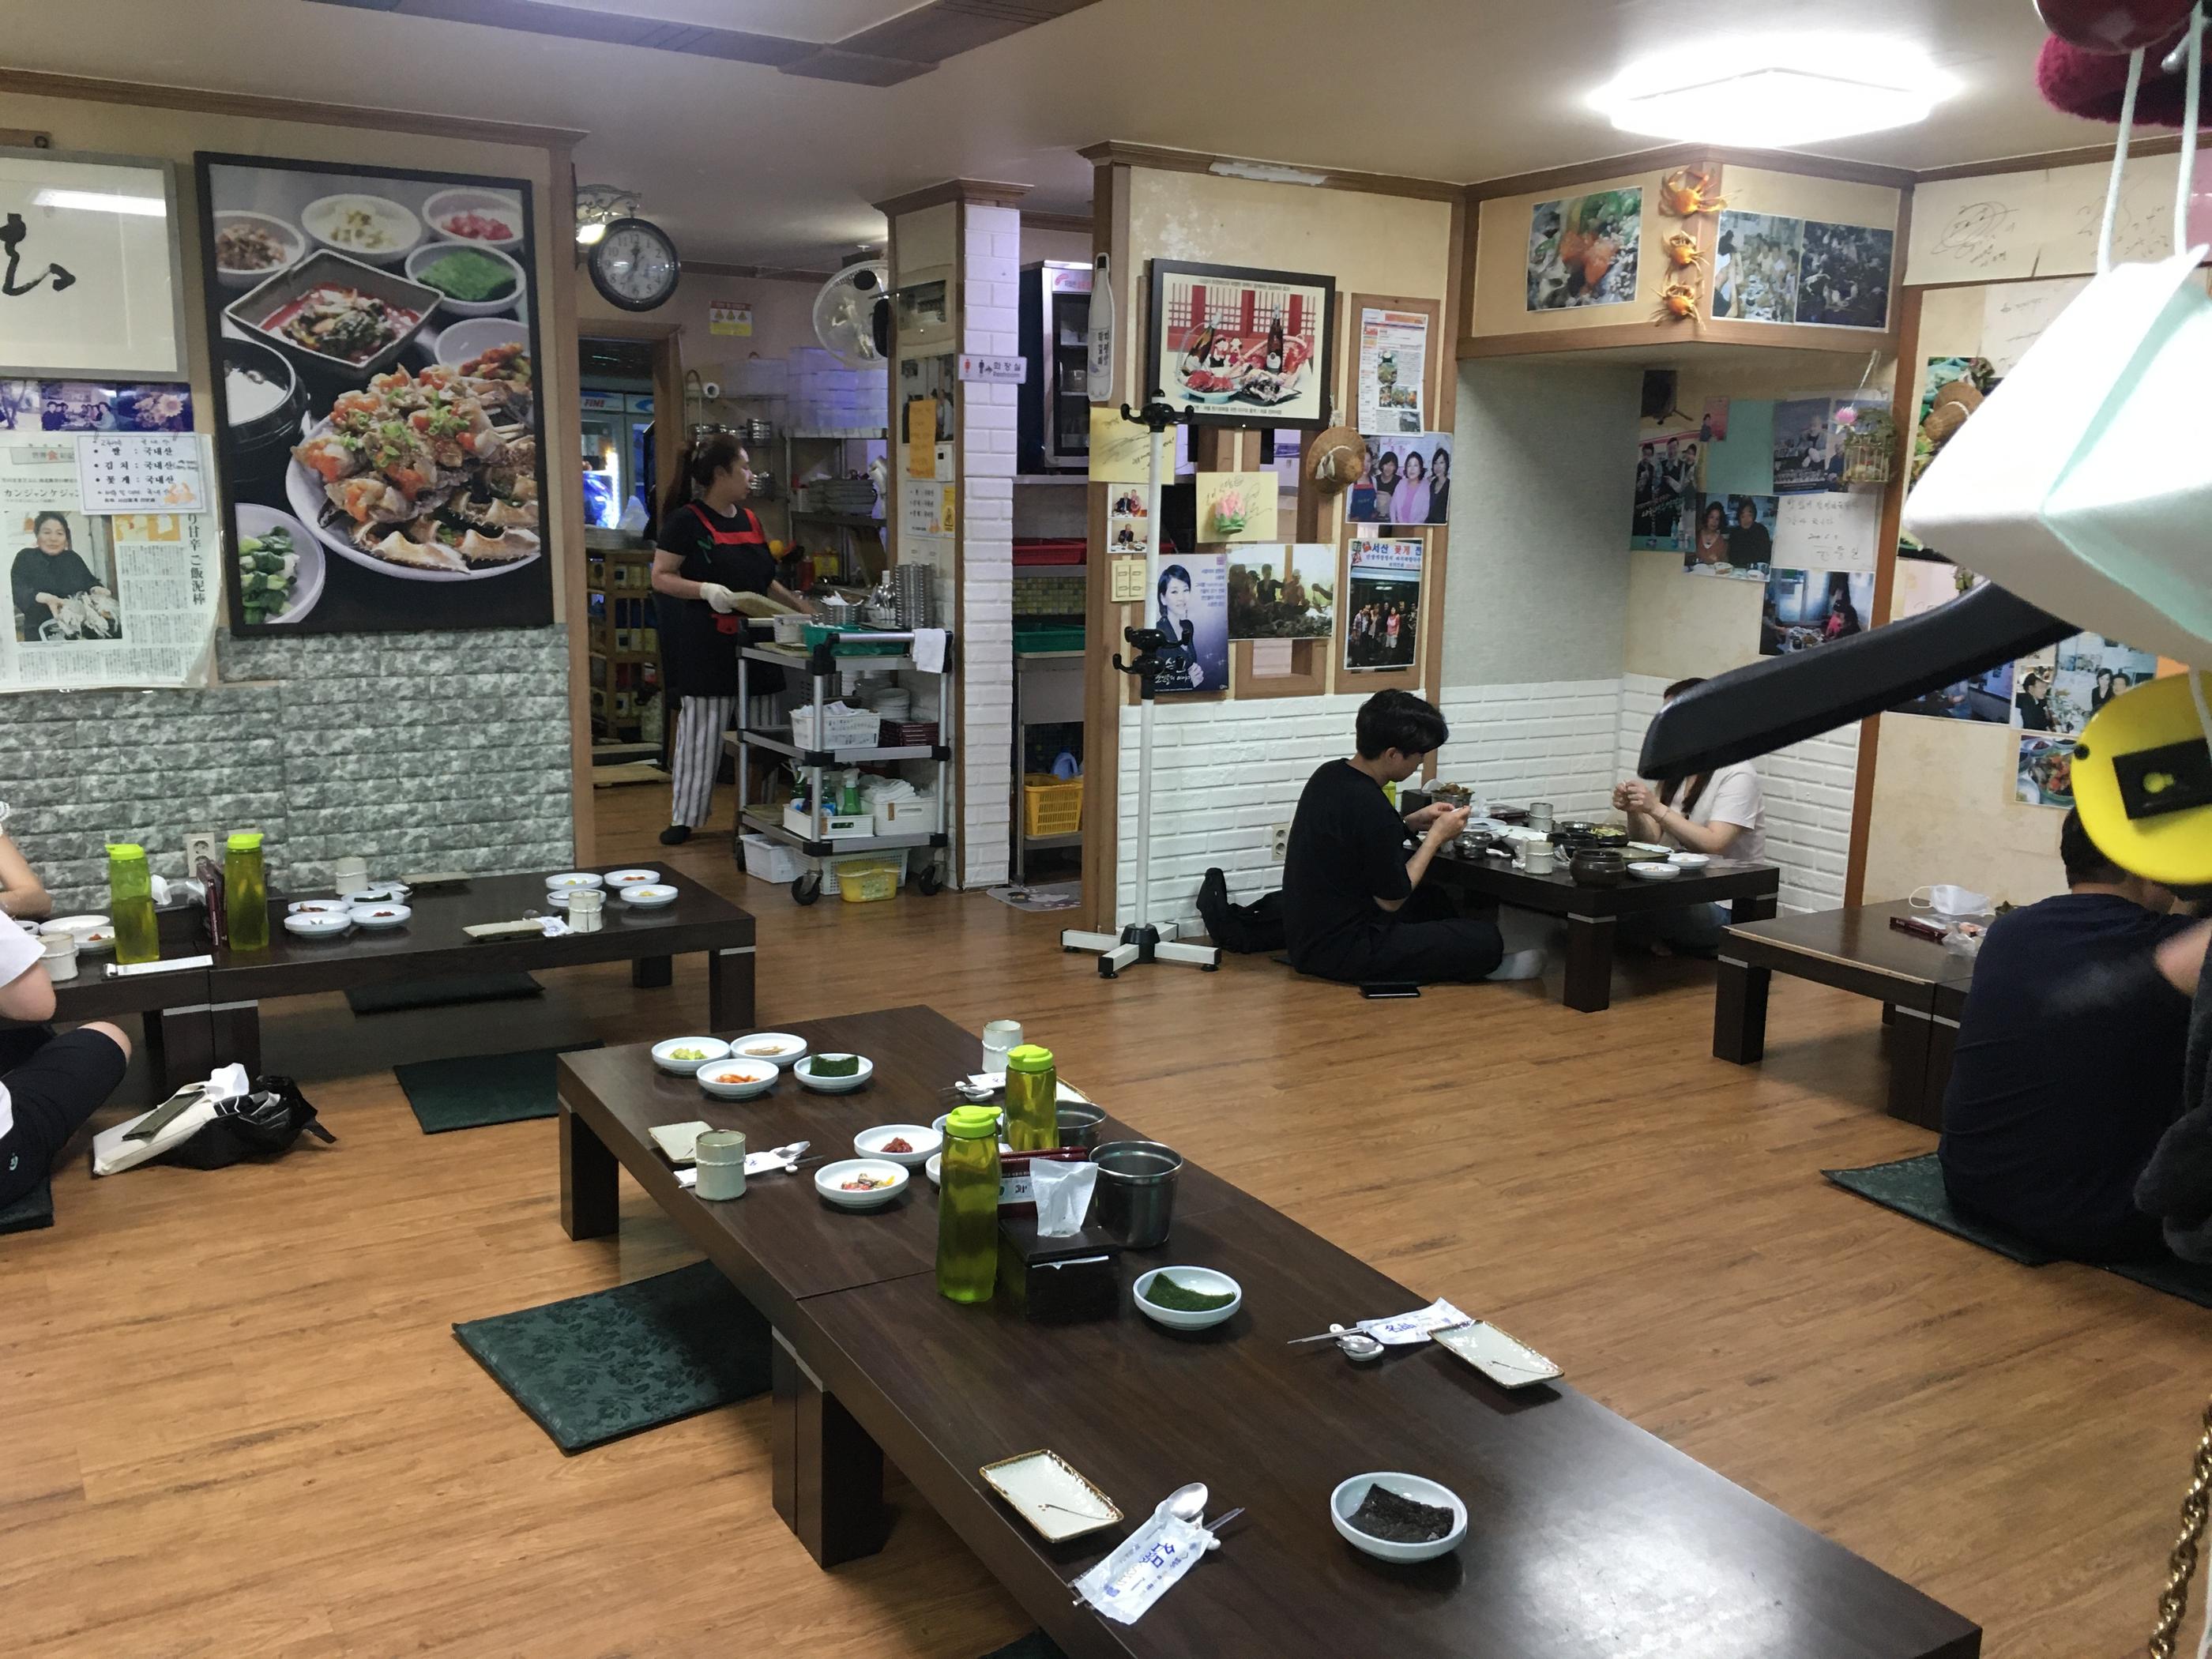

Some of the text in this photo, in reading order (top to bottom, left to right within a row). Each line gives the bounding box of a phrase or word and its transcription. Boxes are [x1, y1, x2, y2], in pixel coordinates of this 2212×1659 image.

[993, 362, 1021, 372] 화장실
[143, 446, 173, 456] 국내산
[144, 461, 173, 470] 국내산
[145, 475, 174, 484] 국내산
[1372, 543, 1389, 555] 서산
[1394, 544, 1410, 555] 꽃게
